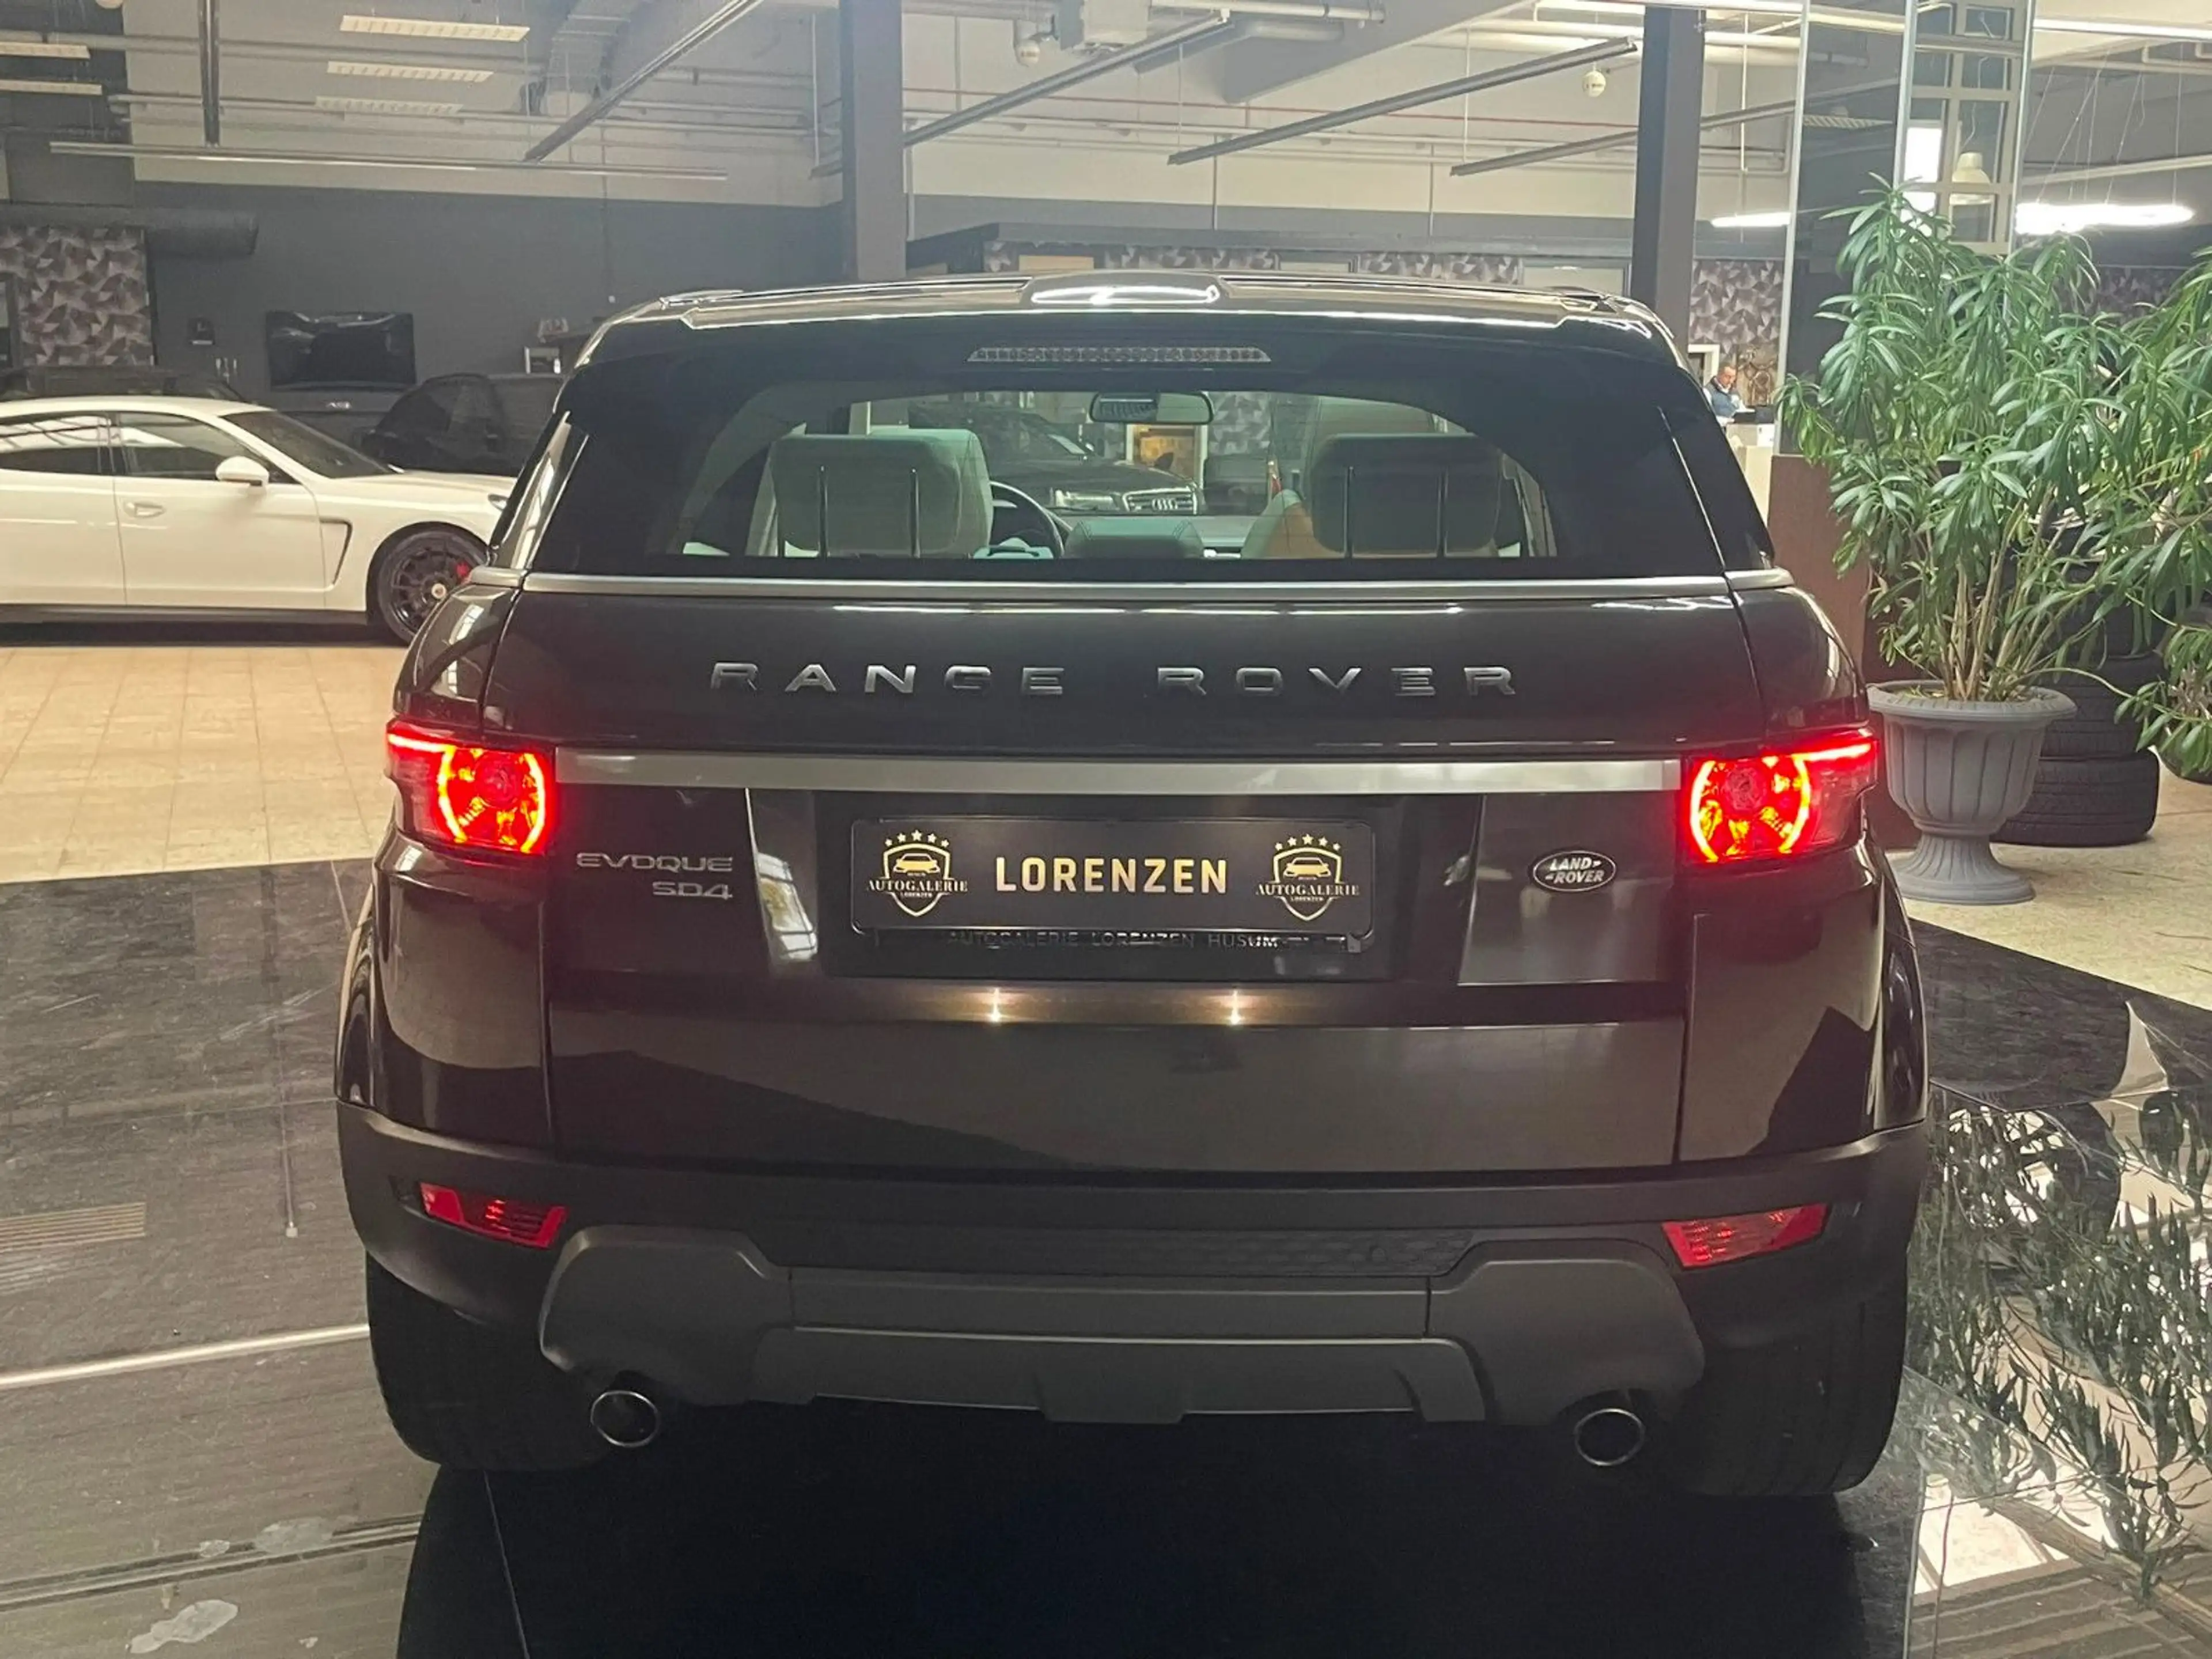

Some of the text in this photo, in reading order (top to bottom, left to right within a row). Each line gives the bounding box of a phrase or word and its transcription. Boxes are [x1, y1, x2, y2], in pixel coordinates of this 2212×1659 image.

[710, 662, 1516, 696] RANGE ROVER
[576, 852, 733, 873] EVOQUE
[996, 857, 1227, 893] LORENZEN
[652, 881, 733, 900] SD4
[866, 880, 968, 892] AUTOGALERIE
[1255, 884, 1360, 896] AUTOGALERIE
[1207, 932, 1280, 948] HUSUM
